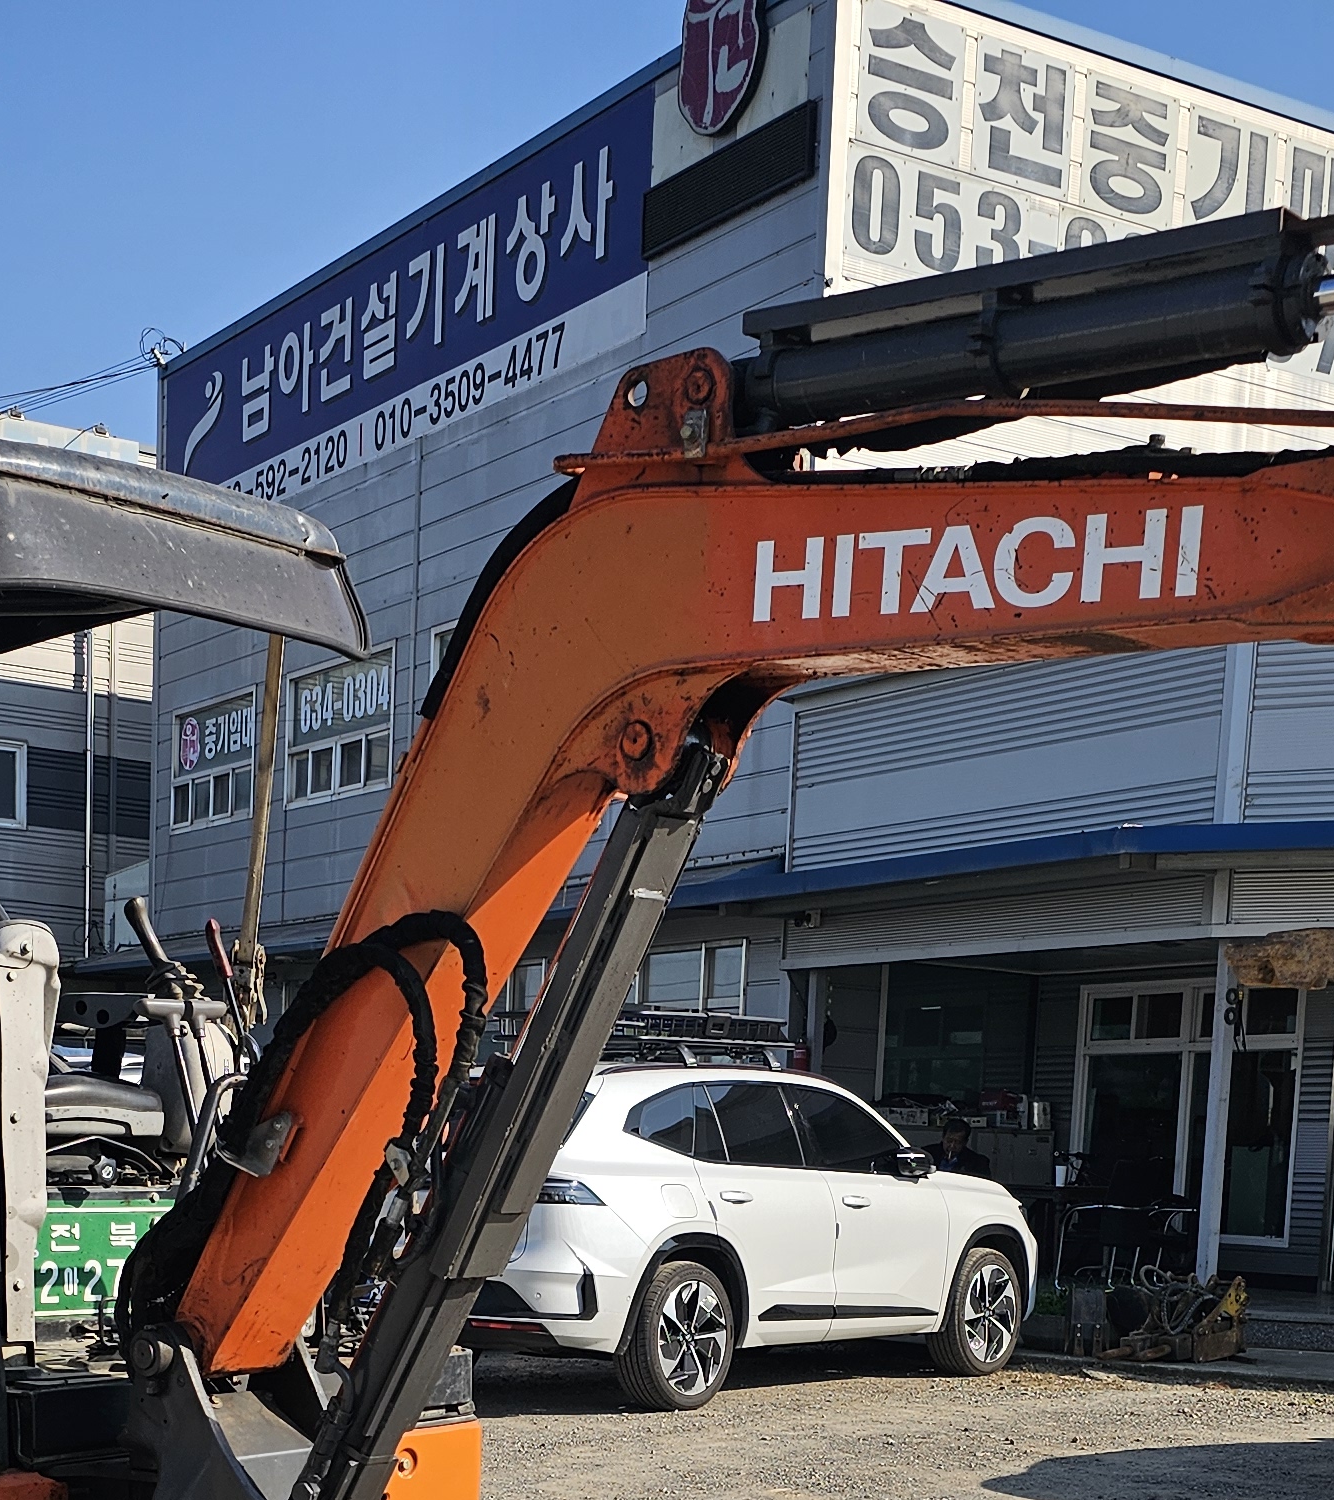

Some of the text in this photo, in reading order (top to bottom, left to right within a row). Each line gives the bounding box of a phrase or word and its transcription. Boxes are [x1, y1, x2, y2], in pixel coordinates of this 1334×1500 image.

[241, 146, 614, 443] 남아건설기계상사
[225, 321, 566, 501] -592-2120 010-3509-4477
[752, 504, 1205, 623] HITACHI
[205, 705, 255, 760] 중기임대
[300, 665, 390, 734] 634-0304
